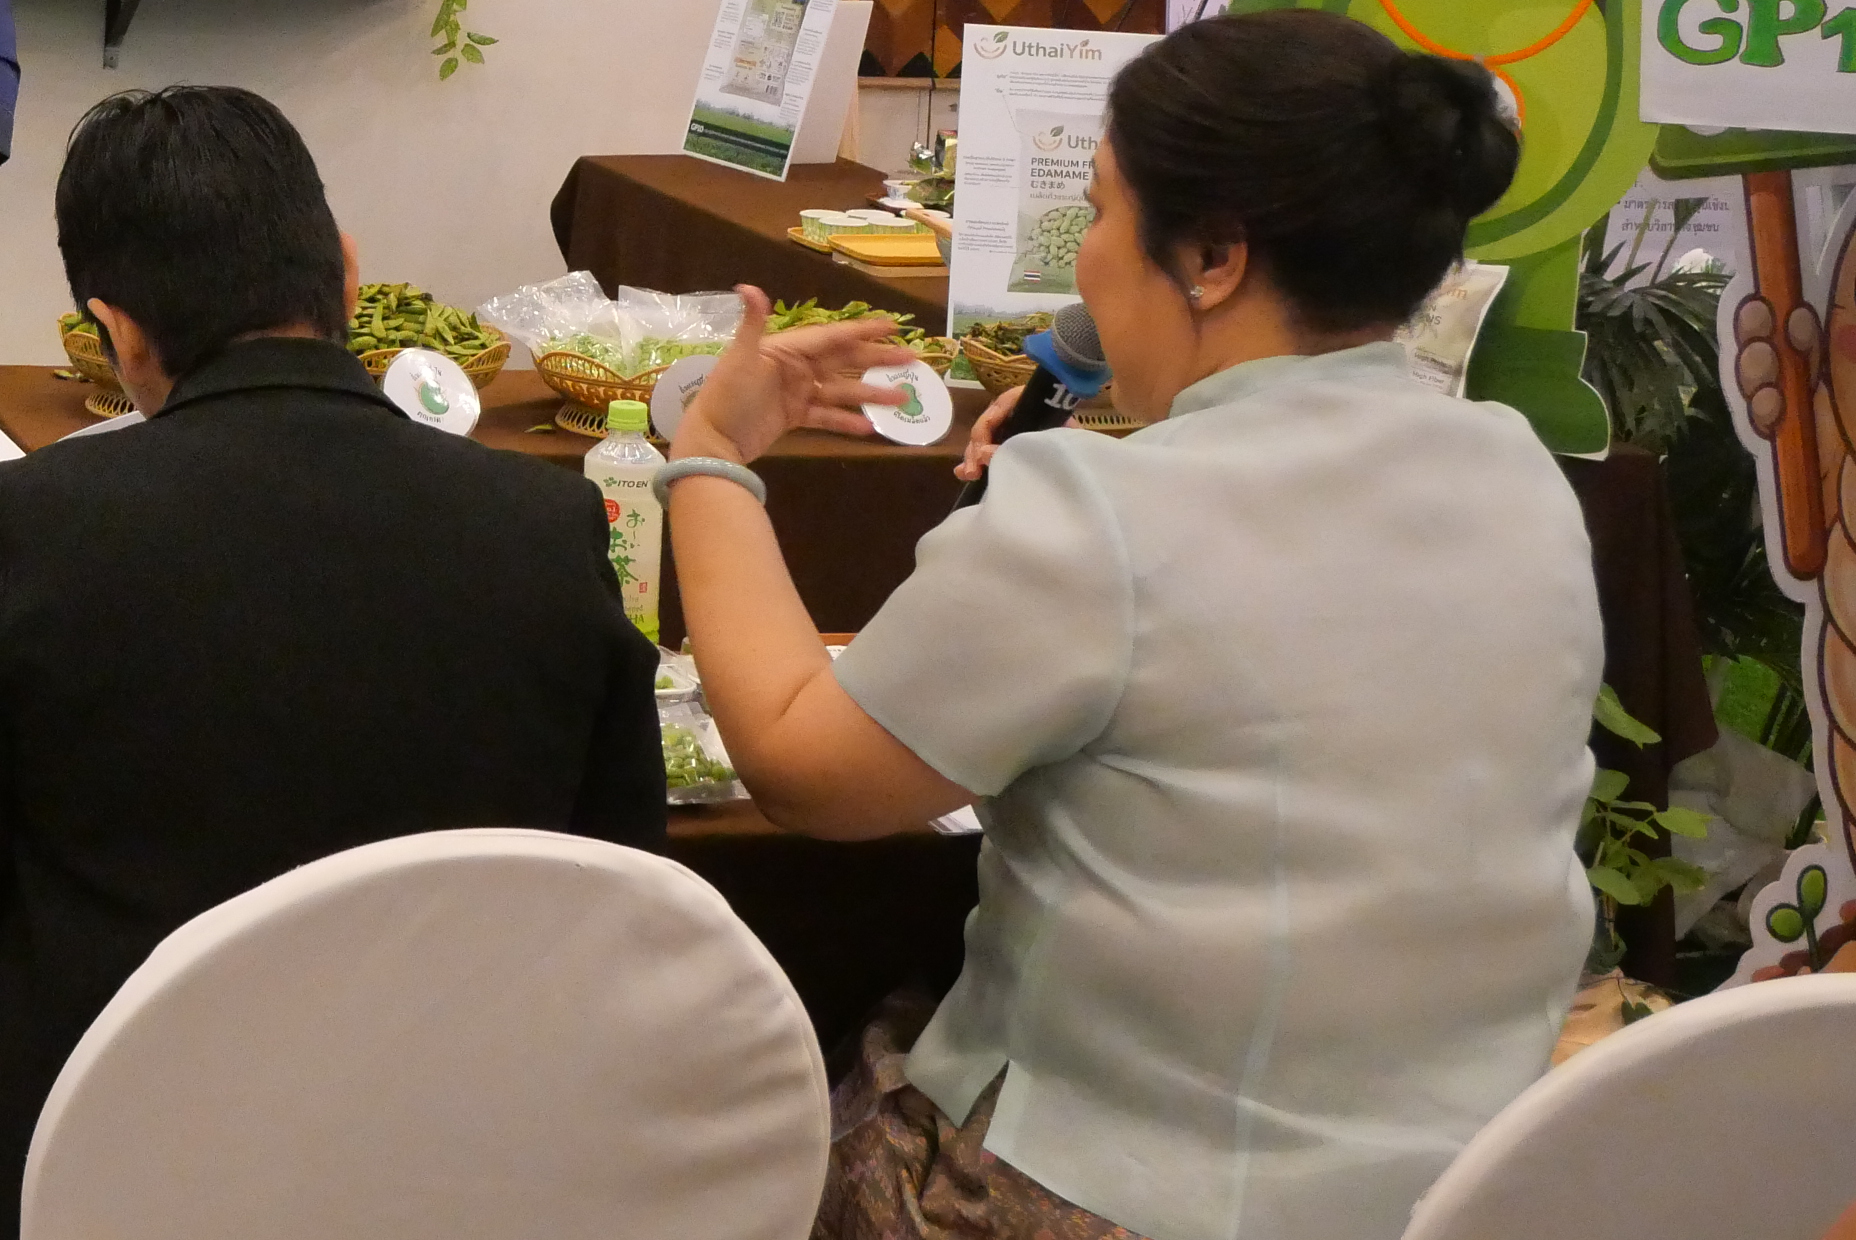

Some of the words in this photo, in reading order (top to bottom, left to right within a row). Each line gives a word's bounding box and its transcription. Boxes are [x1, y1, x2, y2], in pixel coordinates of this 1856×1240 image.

[1012, 38, 1103, 60] UthaiYim
[1031, 157, 1079, 169] PREMIUM
[1030, 168, 1090, 181] EDAMAME
[1030, 180, 1065, 190] むきまめ
